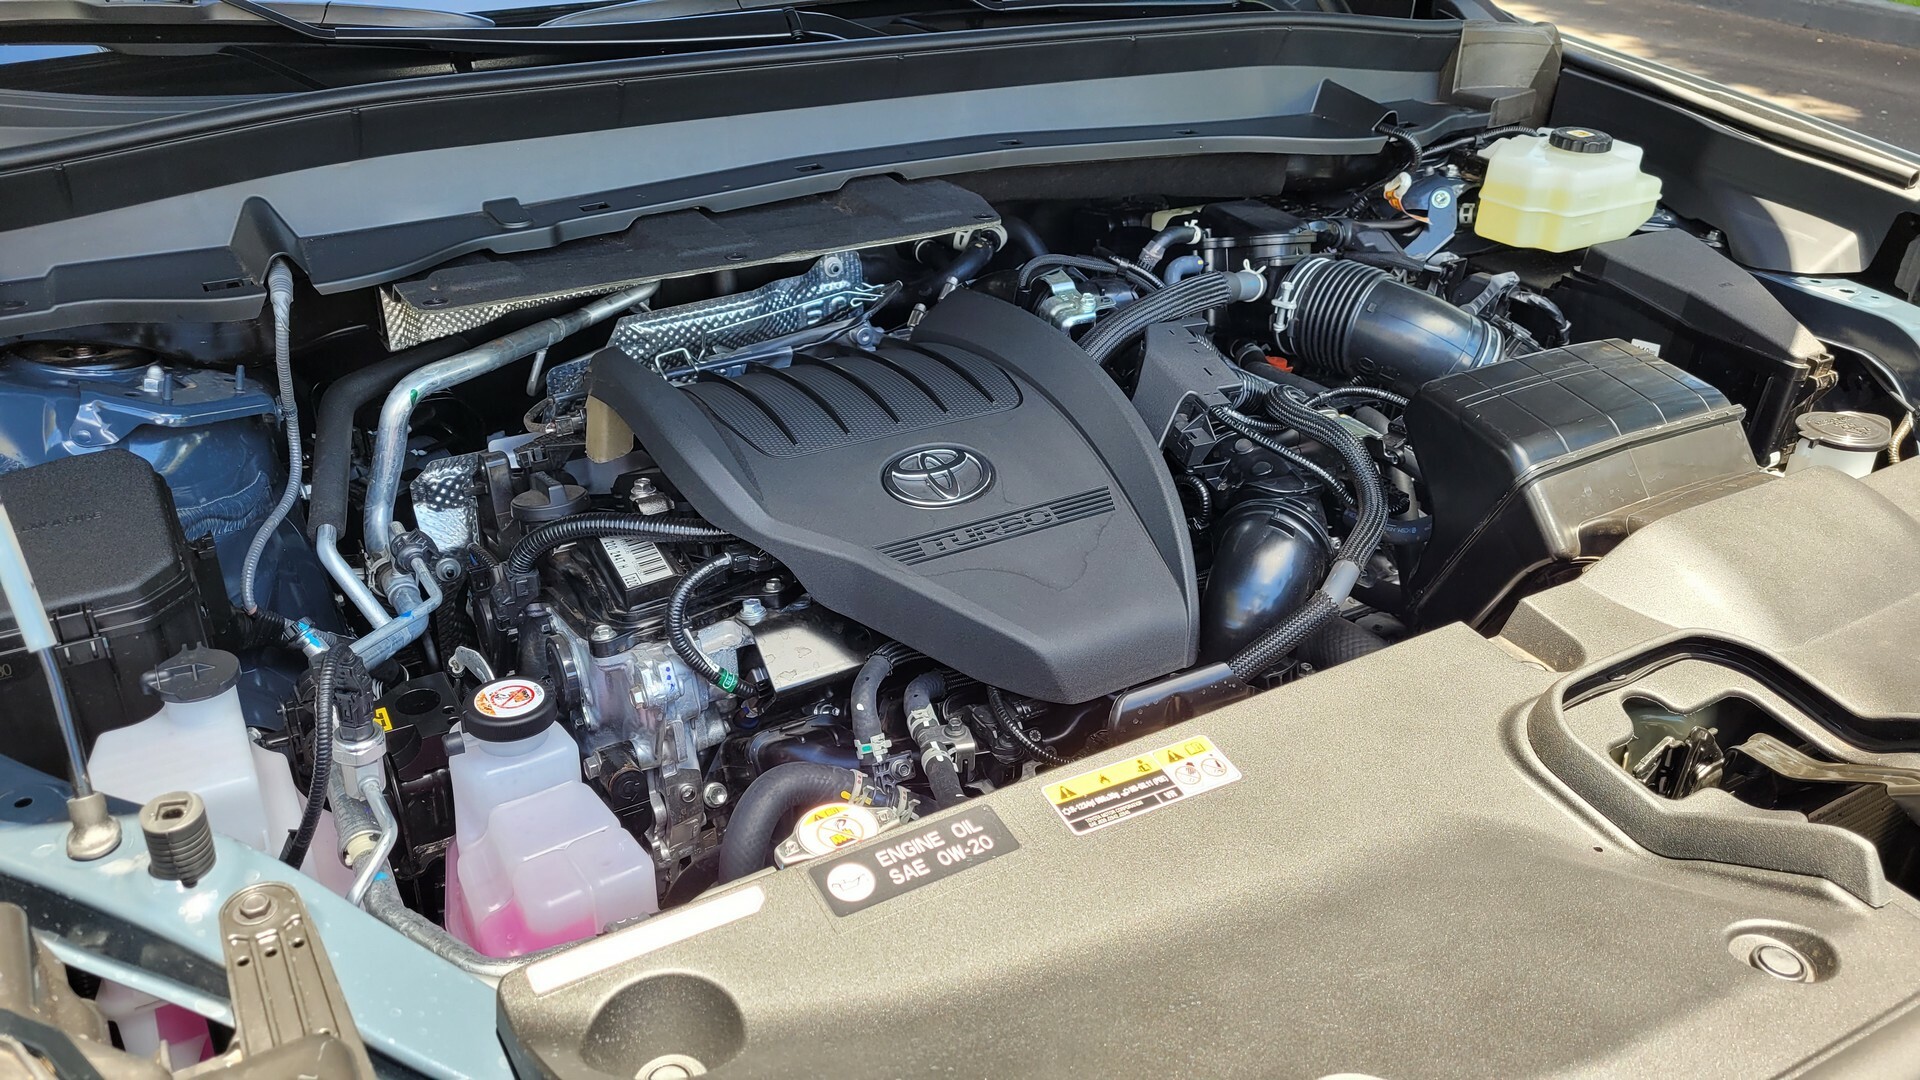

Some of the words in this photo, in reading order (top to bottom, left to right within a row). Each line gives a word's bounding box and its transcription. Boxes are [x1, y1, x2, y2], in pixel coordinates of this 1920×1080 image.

[921, 509, 1054, 552] TURBO
[875, 831, 946, 867] ENGINE
[950, 819, 984, 838] OIL
[889, 859, 931, 885] SAE
[936, 835, 995, 866] 0W-20
